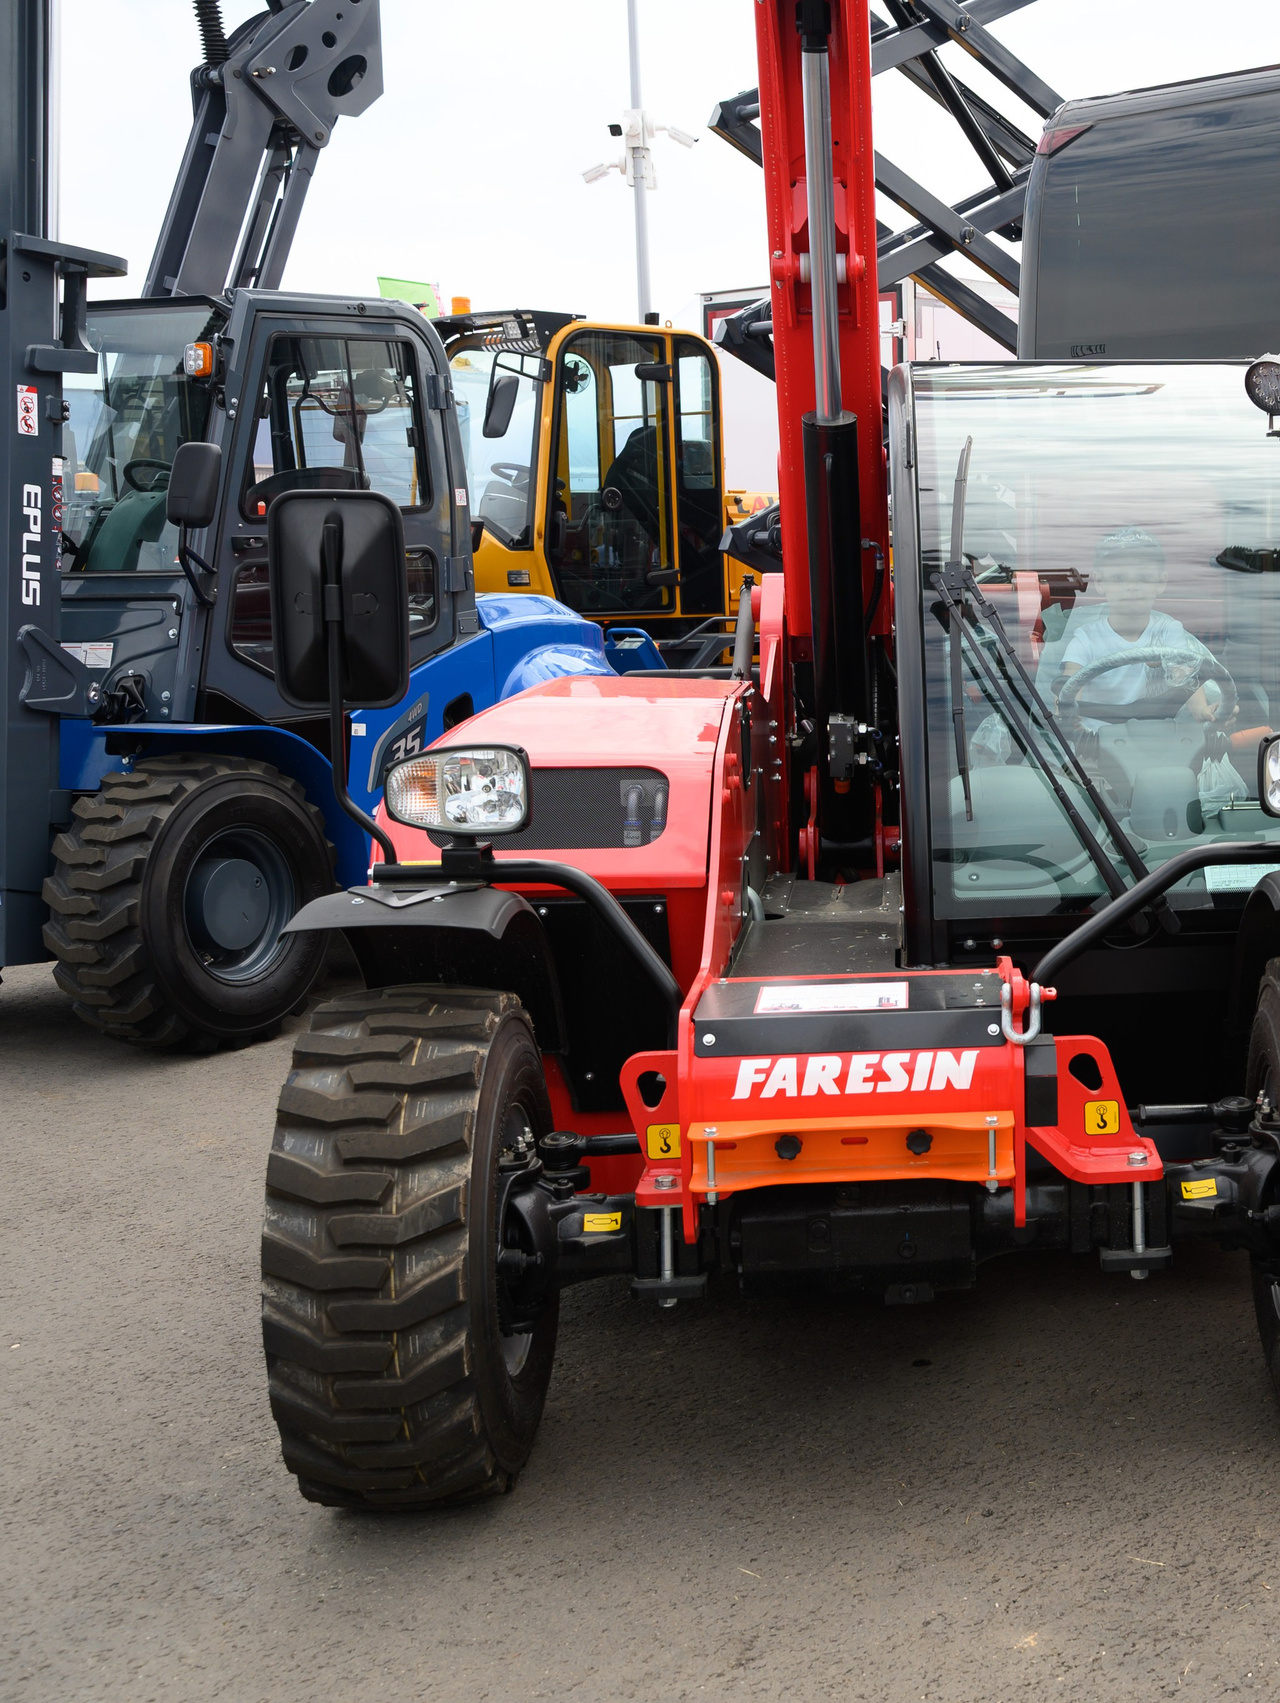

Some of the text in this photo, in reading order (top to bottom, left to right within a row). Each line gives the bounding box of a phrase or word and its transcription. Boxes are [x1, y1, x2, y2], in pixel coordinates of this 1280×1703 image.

[22, 483, 42, 606] EPLUS
[407, 703, 423, 722] 4WD
[391, 726, 421, 760] 35
[731, 1050, 980, 1100] FARESIN
